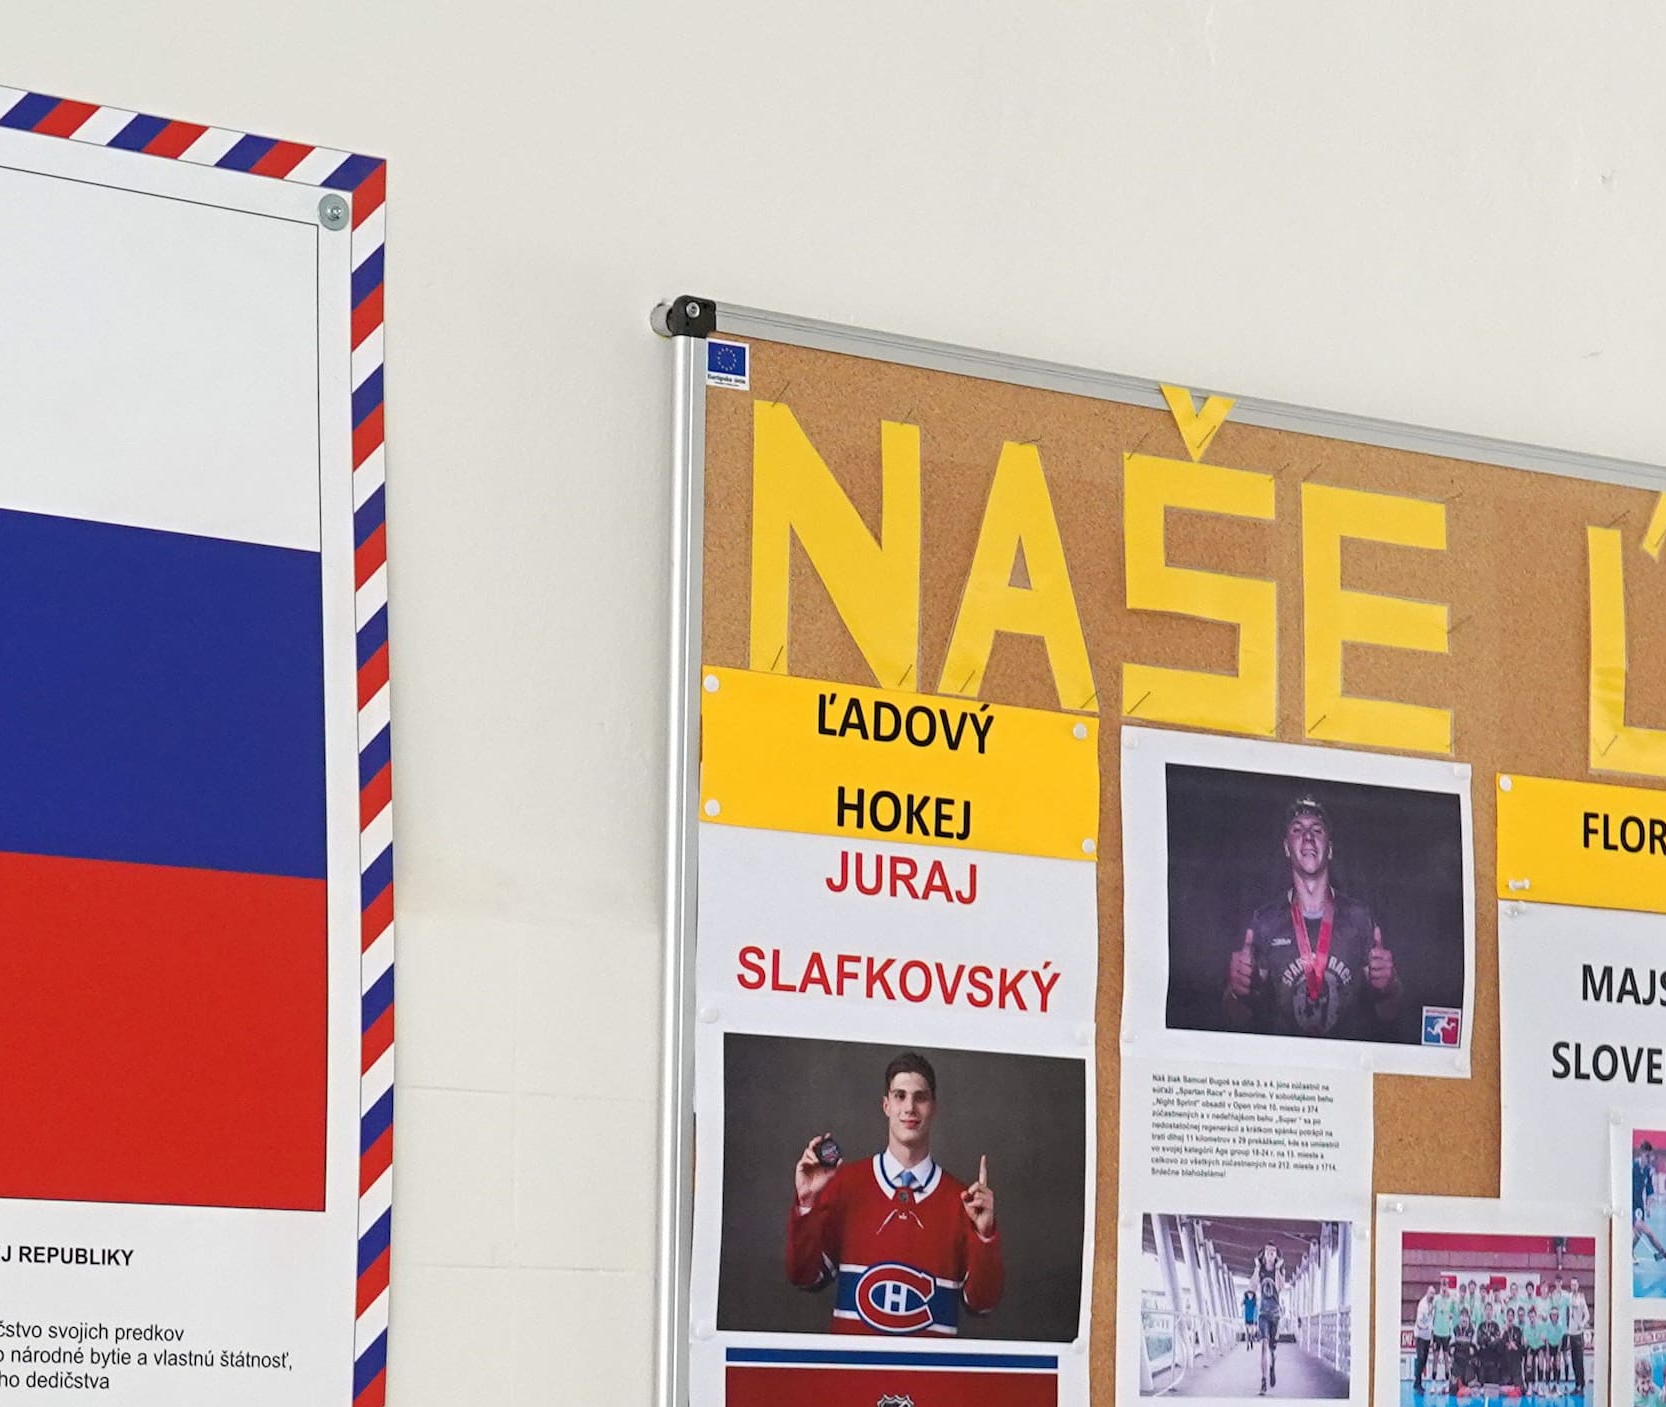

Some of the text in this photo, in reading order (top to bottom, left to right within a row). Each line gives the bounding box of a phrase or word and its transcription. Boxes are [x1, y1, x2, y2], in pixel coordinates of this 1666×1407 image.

[749, 384, 1454, 754] NAŠE
[818, 692, 996, 754] ĽADOVÝ
[837, 786, 970, 841] HOKEJ
[826, 851, 977, 905] JURAJ
[737, 945, 1061, 1013] SLAFKOVSKÝ
[19, 1244, 134, 1267] REPUBLIKY
[48, 1321, 108, 1344] svojich
[115, 1324, 184, 1345] predkov
[26, 1370, 109, 1390] dedičstva
